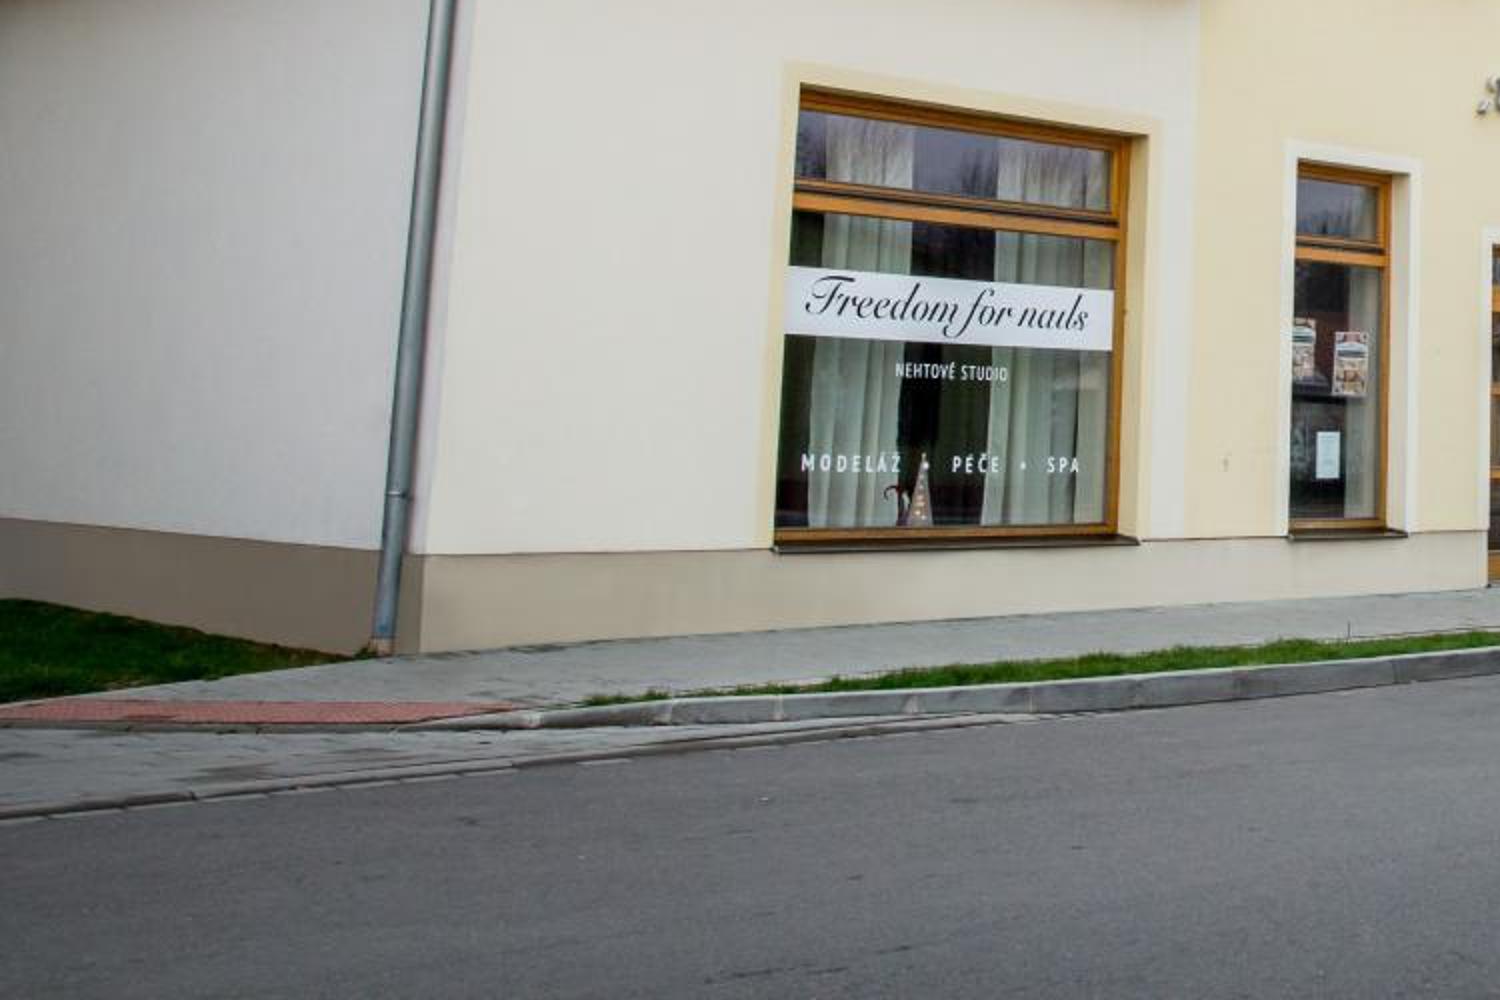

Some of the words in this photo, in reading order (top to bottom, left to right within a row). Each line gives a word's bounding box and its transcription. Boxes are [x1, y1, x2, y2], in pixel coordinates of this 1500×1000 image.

[805, 275, 957, 324] Freedom
[943, 289, 1014, 339] for
[1018, 293, 1089, 332] nails
[895, 362, 956, 381] NEHTOVÉ
[961, 365, 1008, 382] STUDIO
[952, 453, 1000, 474] PÉČE
[1047, 457, 1080, 473] SPA
